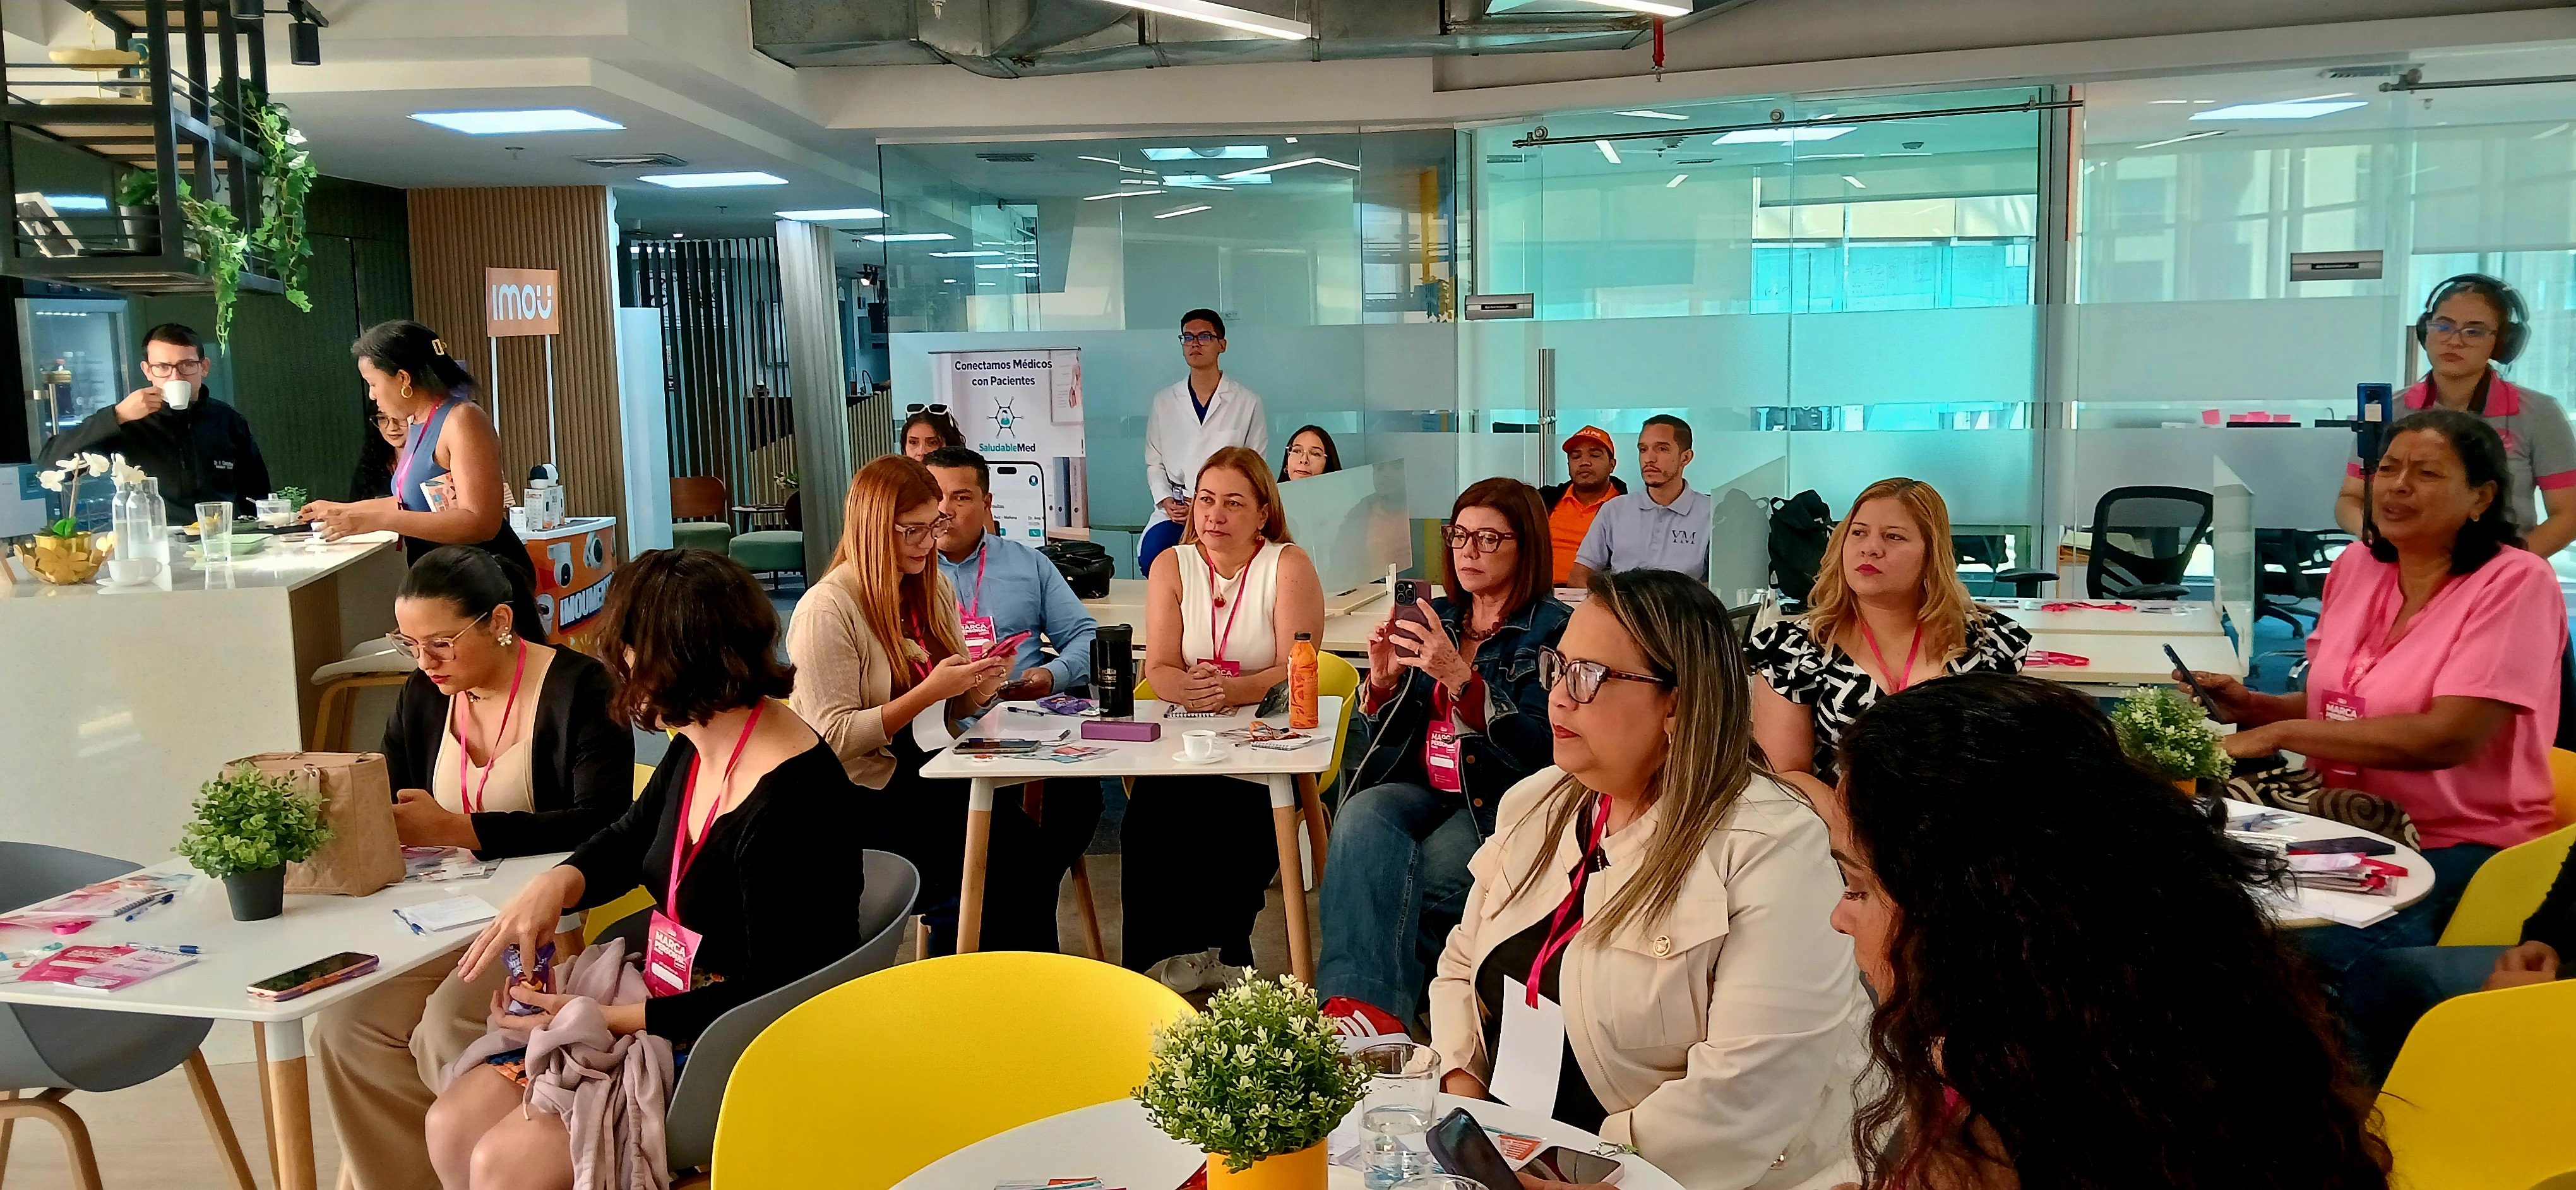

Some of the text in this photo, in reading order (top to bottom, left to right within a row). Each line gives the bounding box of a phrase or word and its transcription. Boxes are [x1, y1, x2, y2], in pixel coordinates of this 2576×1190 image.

[955, 358, 1052, 371] Conectamos Médicos
[972, 376, 1035, 387] con Pacientes
[979, 443, 1036, 453] SaludableMed
[2326, 703, 2358, 719] MARCA
[655, 930, 686, 958] MARCA
